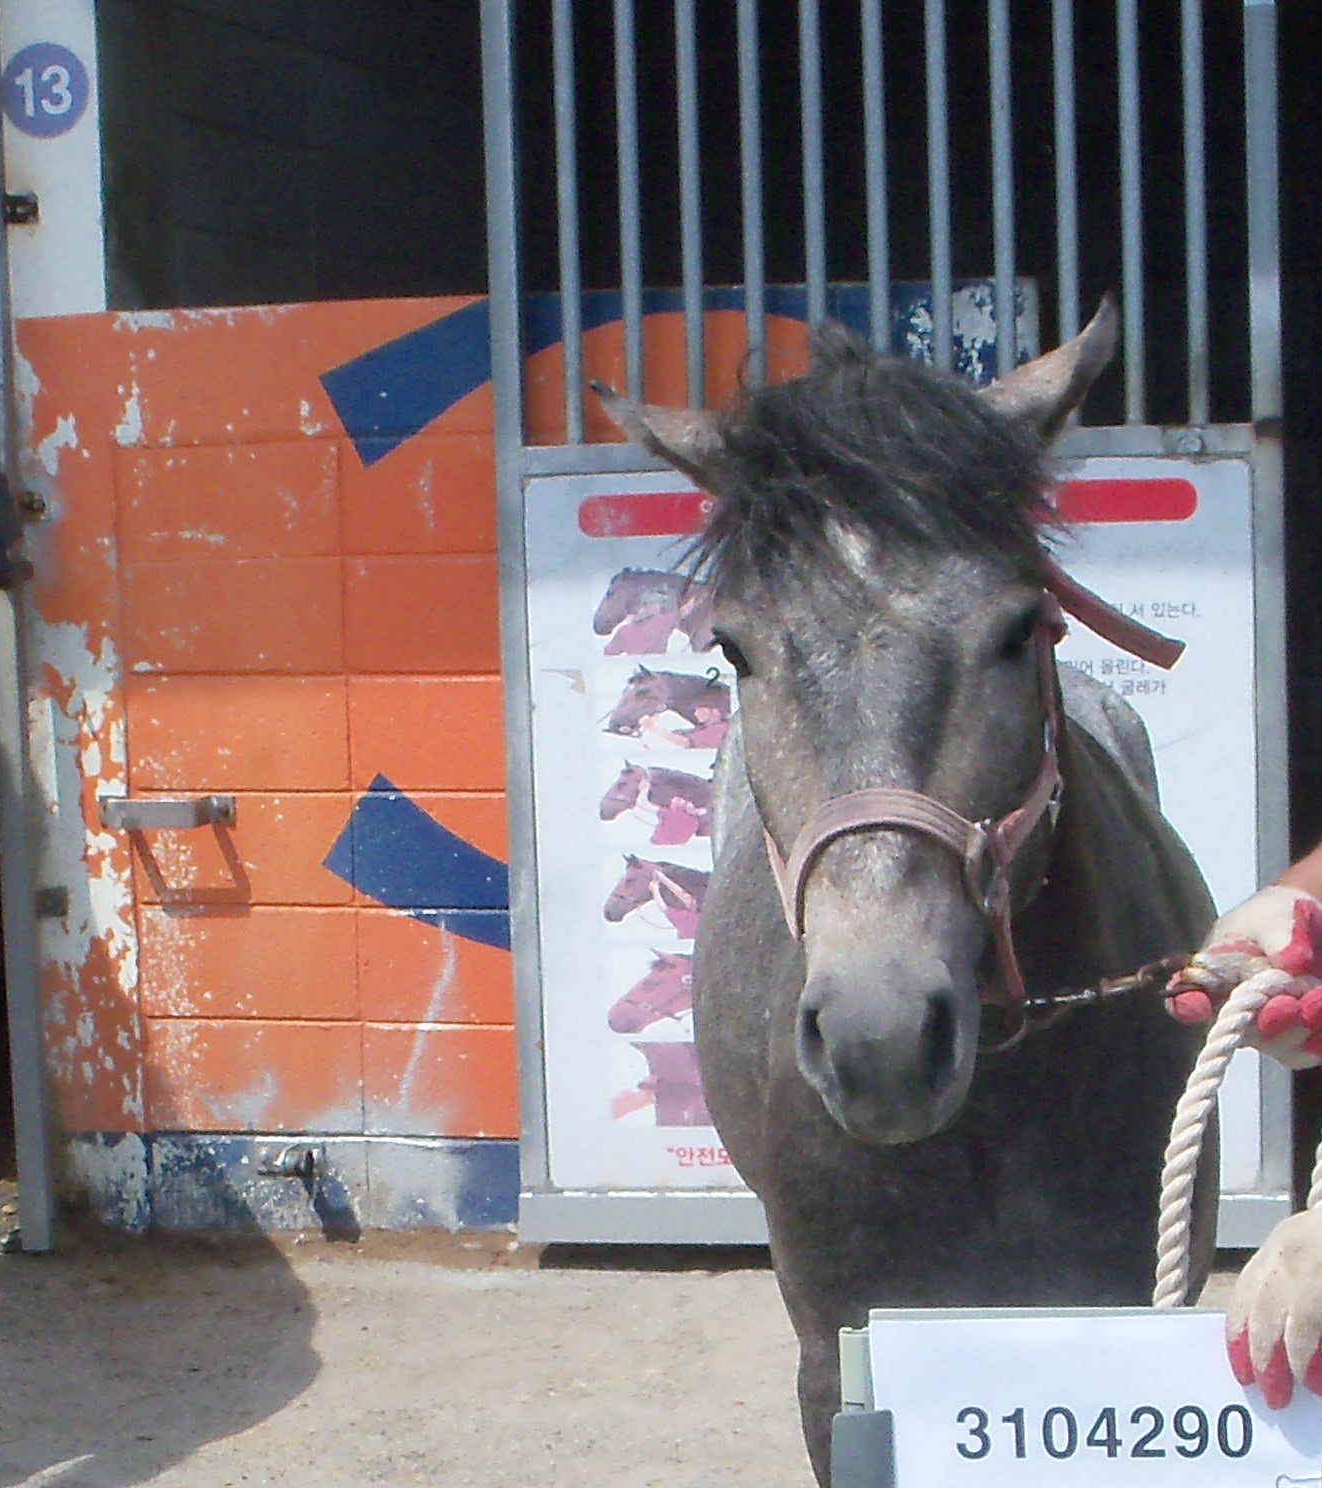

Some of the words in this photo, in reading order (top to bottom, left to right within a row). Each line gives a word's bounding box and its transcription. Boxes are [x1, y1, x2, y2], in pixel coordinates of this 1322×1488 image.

[14, 64, 73, 117] 13
[1151, 602, 1201, 618] 있는다.
[1101, 658, 1150, 675] 올린다.
[955, 1404, 1254, 1461] 3104290
